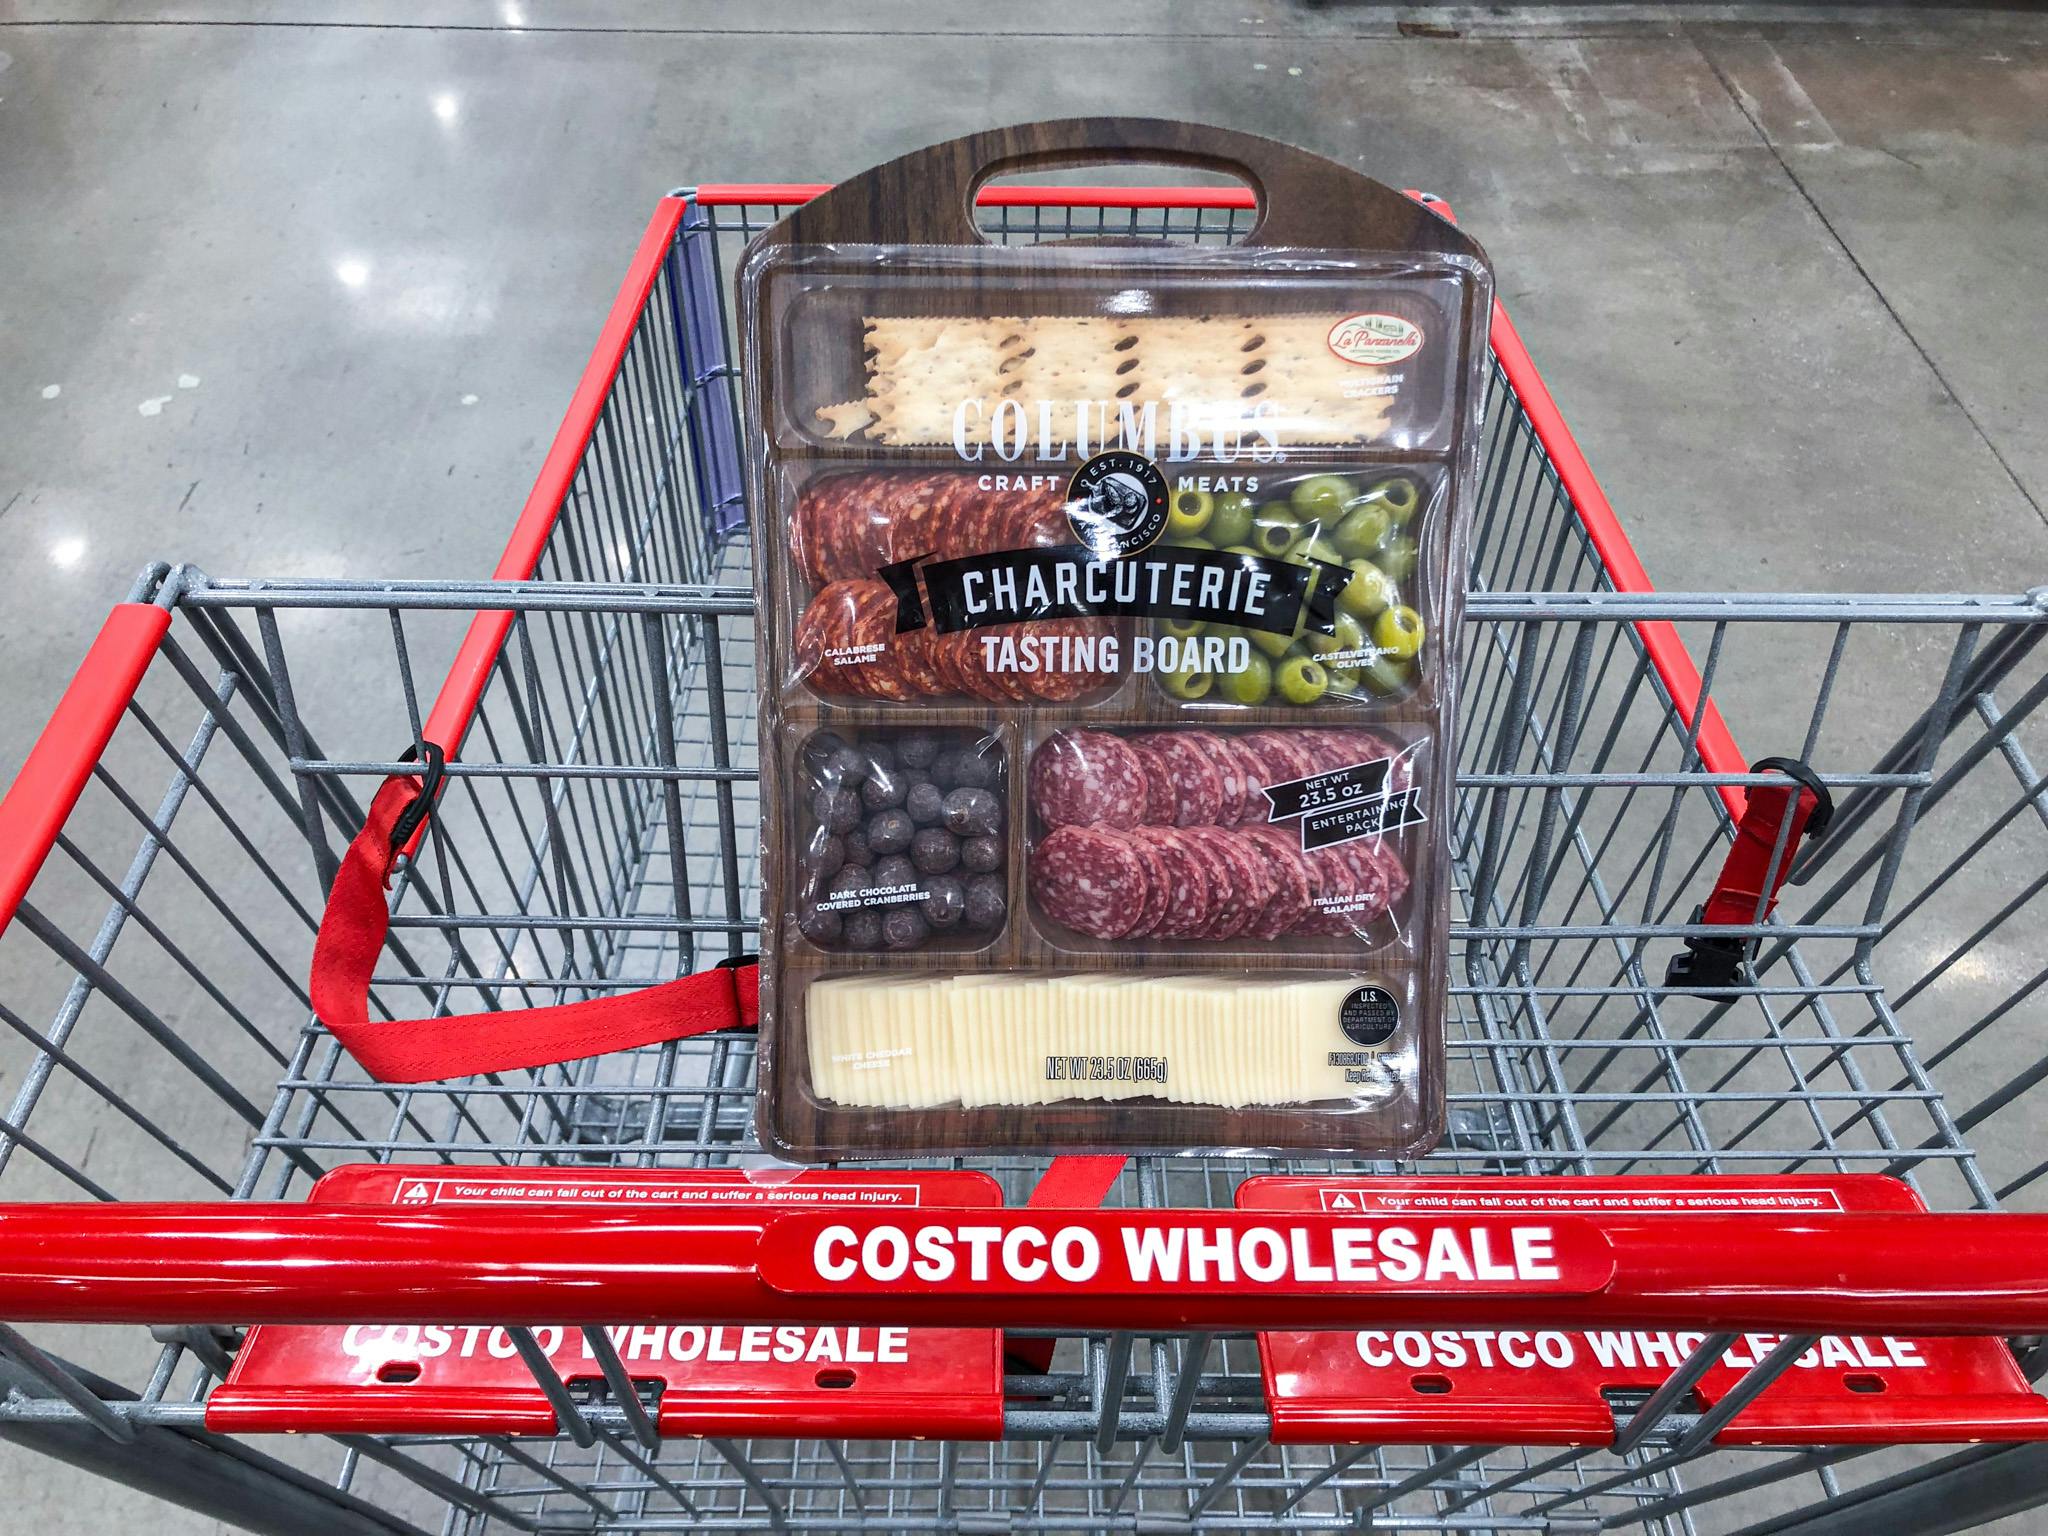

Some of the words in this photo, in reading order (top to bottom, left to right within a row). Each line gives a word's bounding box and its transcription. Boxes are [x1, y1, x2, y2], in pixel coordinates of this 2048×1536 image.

[1332, 330, 1352, 349] La
[952, 399, 1280, 464] COLUMBUS
[1090, 458, 1122, 476] EST.
[1129, 460, 1158, 484] 1917
[978, 475, 1060, 491] CRAFT
[1178, 476, 1259, 492] MEATS
[962, 560, 1272, 616] CHARCUTERIE
[824, 643, 886, 657] CALABRESE
[981, 636, 1119, 673] TASTING
[1133, 636, 1250, 673] BOARD
[834, 653, 877, 666] SALAME
[1336, 659, 1375, 669] OLIVES
[1305, 777, 1328, 791] NET
[1331, 772, 1350, 784] WT
[1299, 787, 1337, 809] 23.5
[1311, 798, 1407, 830] ENTERTAINING
[1346, 818, 1381, 834] PACK
[829, 889, 857, 901] DARK
[859, 883, 917, 897] CHOCOLATE
[1313, 894, 1354, 907] ITALIAN
[1355, 892, 1376, 903] DRY
[816, 899, 861, 912] COVERED
[863, 891, 931, 906] CRANBERRIES
[1323, 902, 1365, 915] SALAME
[1360, 991, 1378, 1002] U.S.
[1351, 1002, 1388, 1010] INSPECTED
[1046, 1056, 1068, 1080] NET
[1069, 1056, 1088, 1080] WT
[1090, 1056, 1115, 1080] 23.5
[1116, 1056, 1132, 1080] OZ
[1133, 1056, 1168, 1083] (665g)
[1345, 1068, 1360, 1084] Keep
[455, 1186, 488, 1197] Your
[491, 1187, 526, 1197] child
[528, 1189, 555, 1198] can
[557, 1188, 577, 1198] fall
[581, 1190, 605, 1199] out
[608, 1189, 624, 1199] of
[625, 1189, 648, 1199] the
[651, 1190, 679, 1199] cart
[681, 1190, 708, 1199] and
[711, 1190, 751, 1200] suffer
[755, 1192, 763, 1200] a
[767, 1191, 818, 1200] serious
[823, 1191, 856, 1200] head
[860, 1191, 902, 1203] injury.
[1377, 1196, 1410, 1206] Your
[1414, 1196, 1448, 1206] child
[1451, 1198, 1477, 1206] can
[1480, 1197, 1501, 1206] fall
[1504, 1198, 1528, 1206] out
[1531, 1197, 1545, 1206] of
[1548, 1197, 1570, 1206] the
[1573, 1198, 1600, 1206] cart
[1603, 1197, 1629, 1206] and
[1632, 1196, 1671, 1206] suffer
[1676, 1198, 1684, 1206] a
[1688, 1197, 1738, 1206] serious
[1742, 1196, 1775, 1205] head
[1779, 1196, 1823, 1207] injury.
[813, 1226, 1101, 1282] COSTCO
[1122, 1227, 1560, 1282] WHOLESALE
[1355, 1331, 1574, 1368] COSTCO
